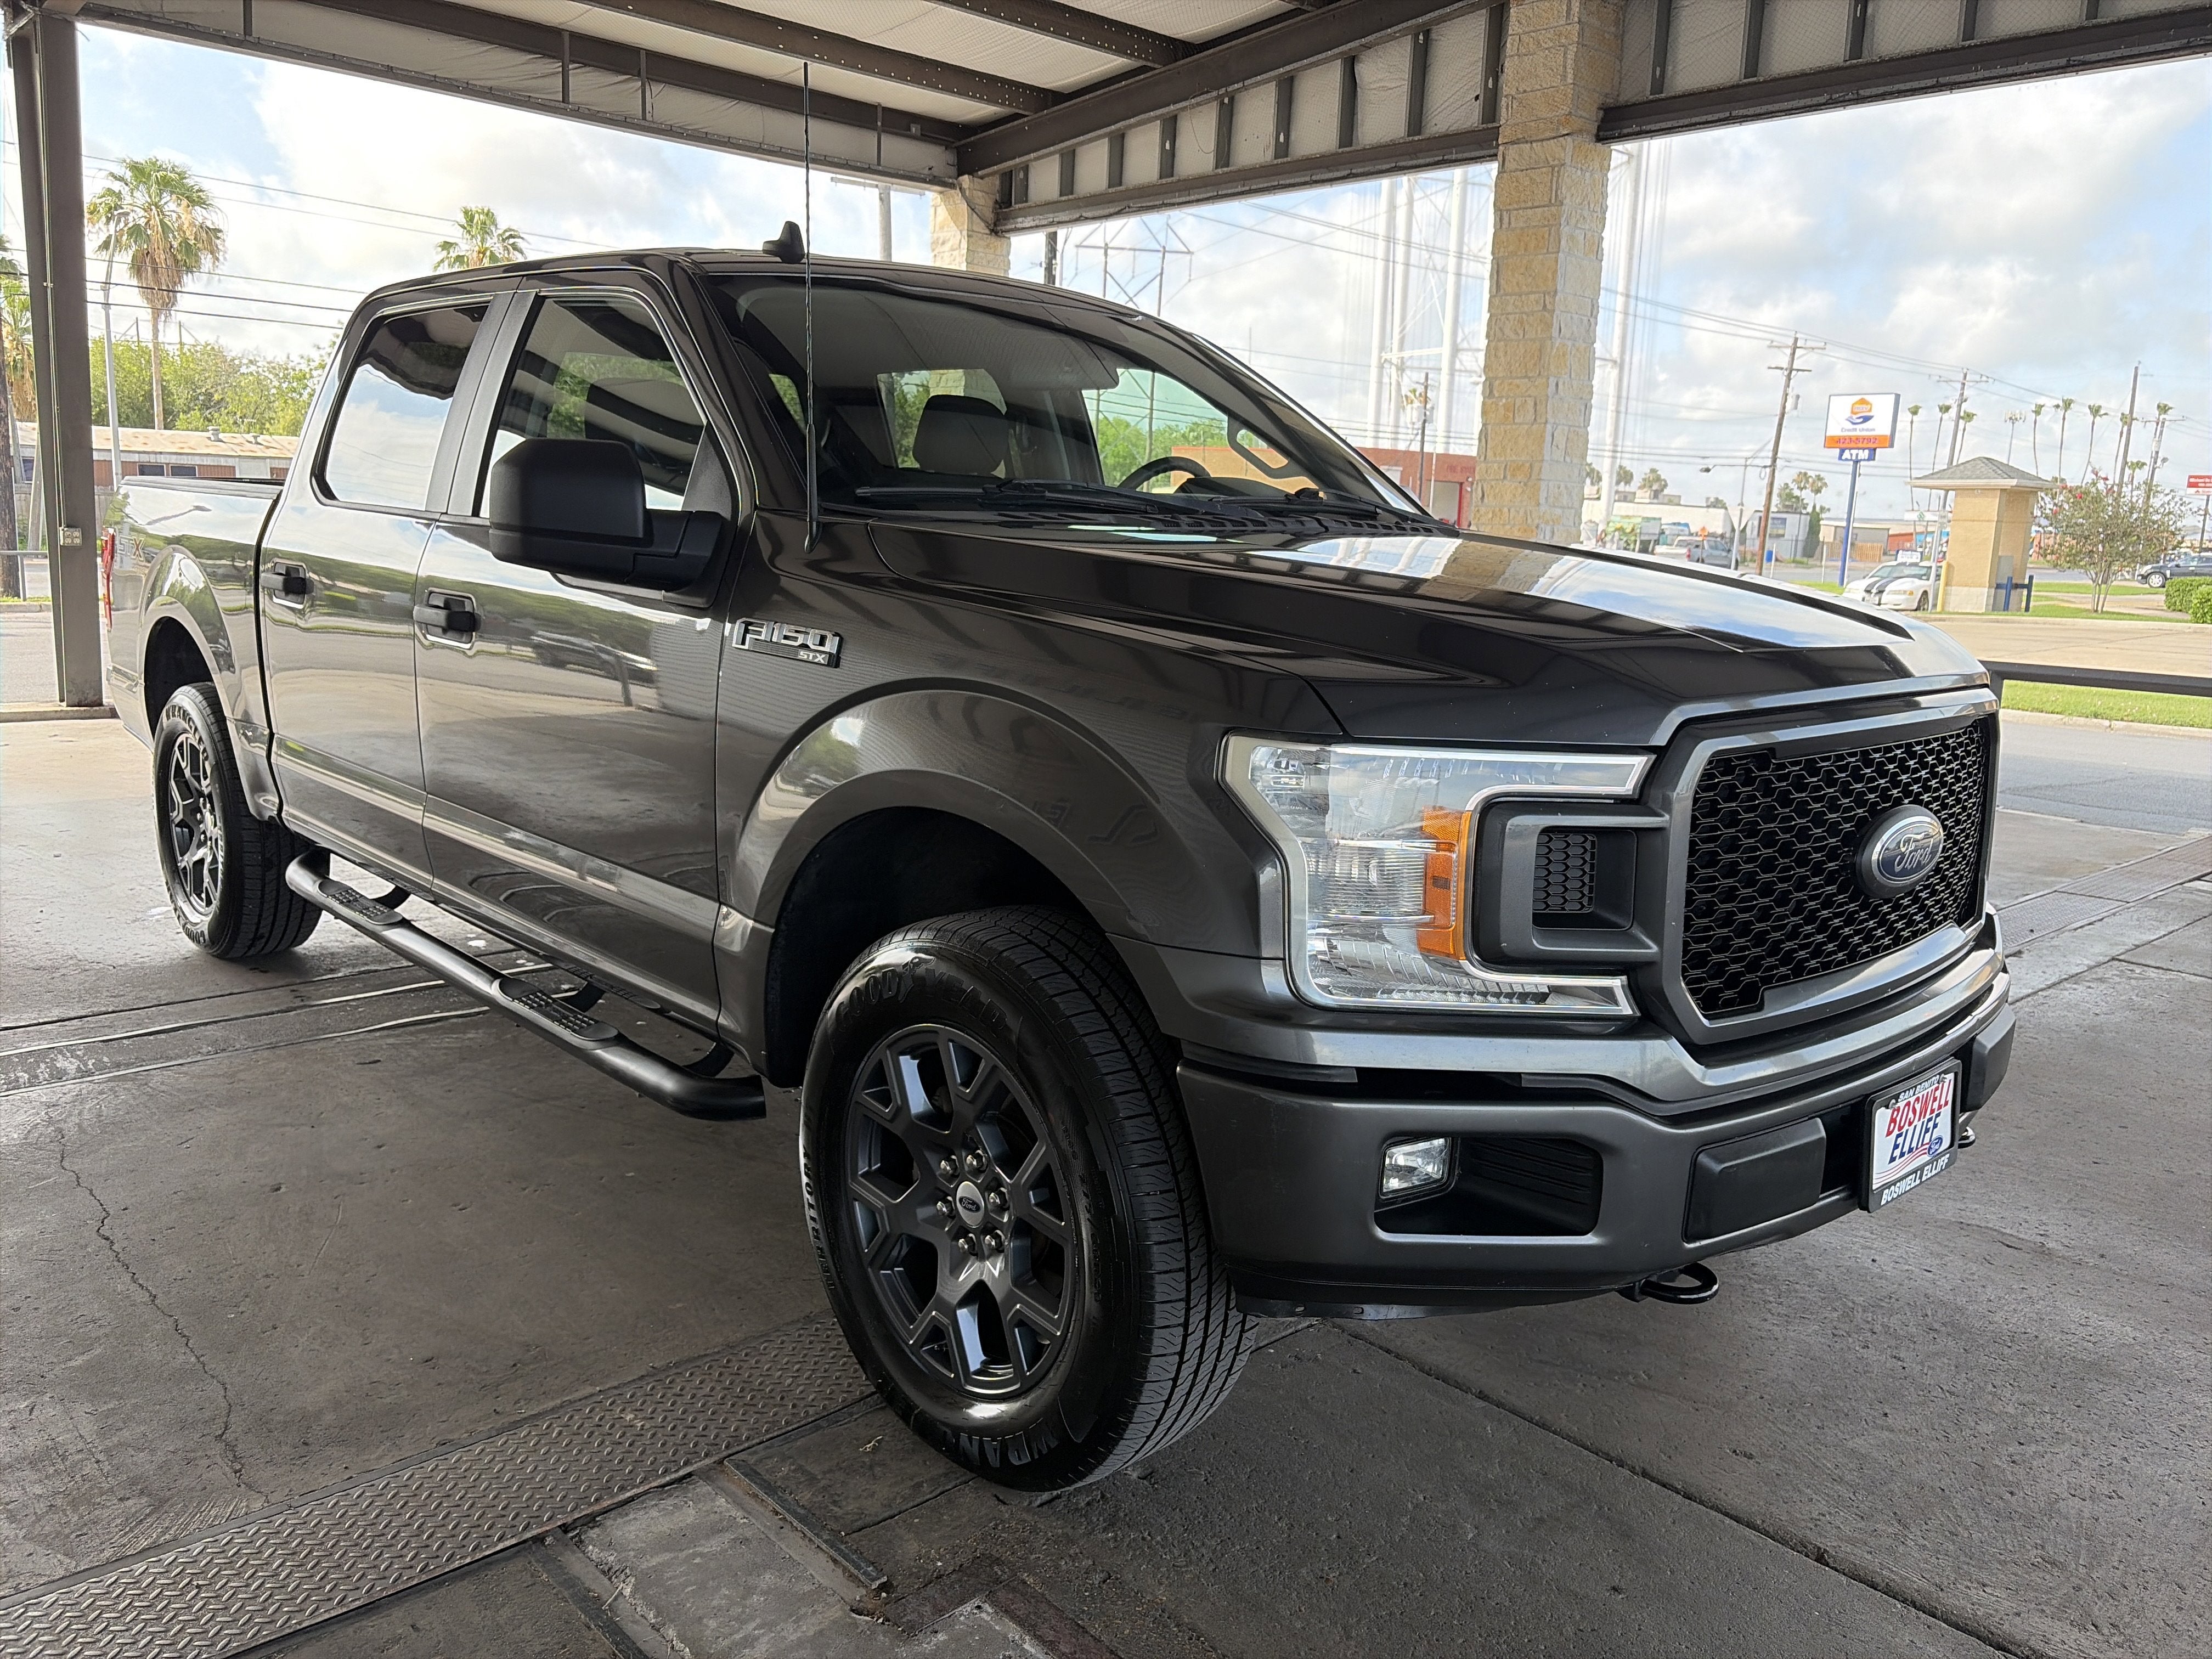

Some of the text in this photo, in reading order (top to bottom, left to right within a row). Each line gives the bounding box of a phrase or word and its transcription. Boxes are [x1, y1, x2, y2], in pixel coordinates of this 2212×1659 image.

[1841, 449, 1869, 460] ATM
[117, 534, 145, 561] STX
[798, 651, 826, 663] STX
[1894, 833, 1934, 872] Ford
[835, 966, 1008, 1034] GOODYEAR
[1898, 1074, 1940, 1102] SAN BENITO
[1885, 1078, 1953, 1138] BOSWELL
[1888, 1111, 1941, 1165] ELLIFF
[1881, 1153, 1950, 1206] BOSWELL ELLIFF
[961, 1198, 977, 1211] Ford
